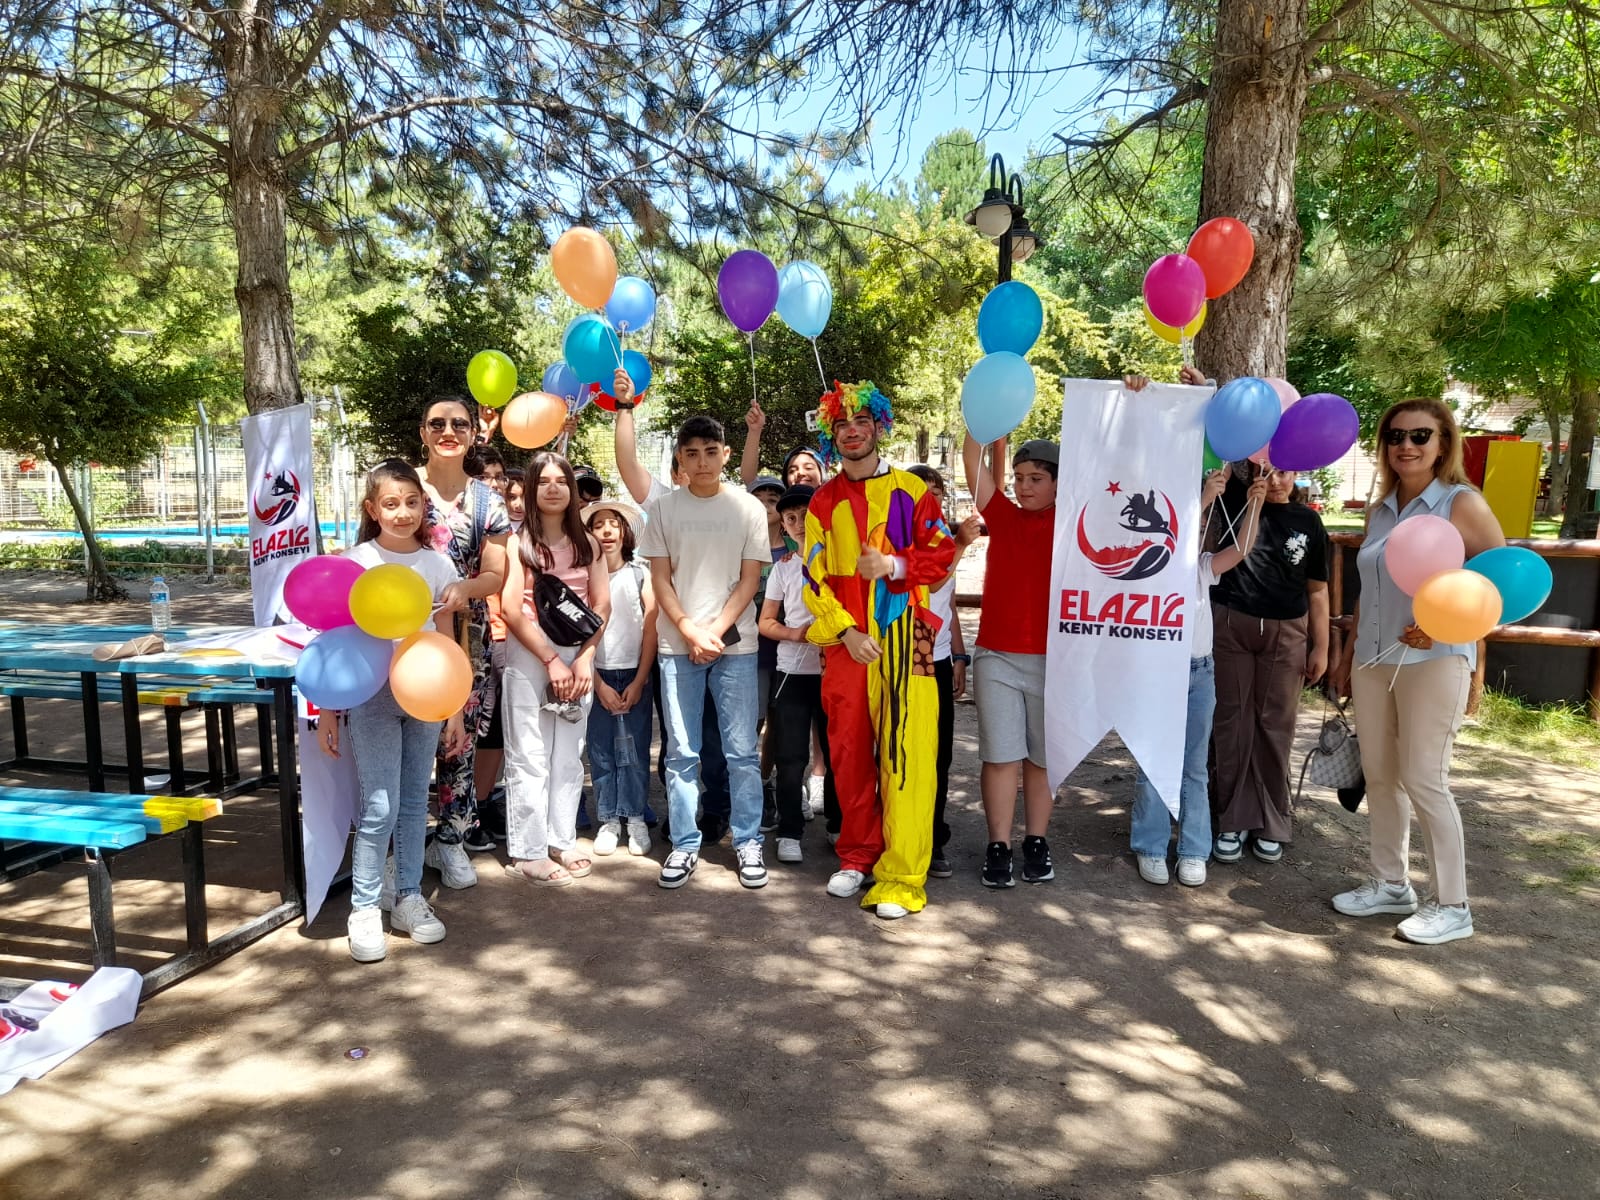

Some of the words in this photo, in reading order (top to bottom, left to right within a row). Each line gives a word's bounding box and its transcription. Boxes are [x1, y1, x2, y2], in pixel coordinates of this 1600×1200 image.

[252, 525, 309, 559] ELAZIĞ
[253, 555, 269, 567] KENT
[556, 600, 585, 622] NIKE
[1060, 589, 1185, 627] ELAZIĞ
[1059, 621, 1104, 636] KENT
[1109, 625, 1182, 642] KONSEYİ
